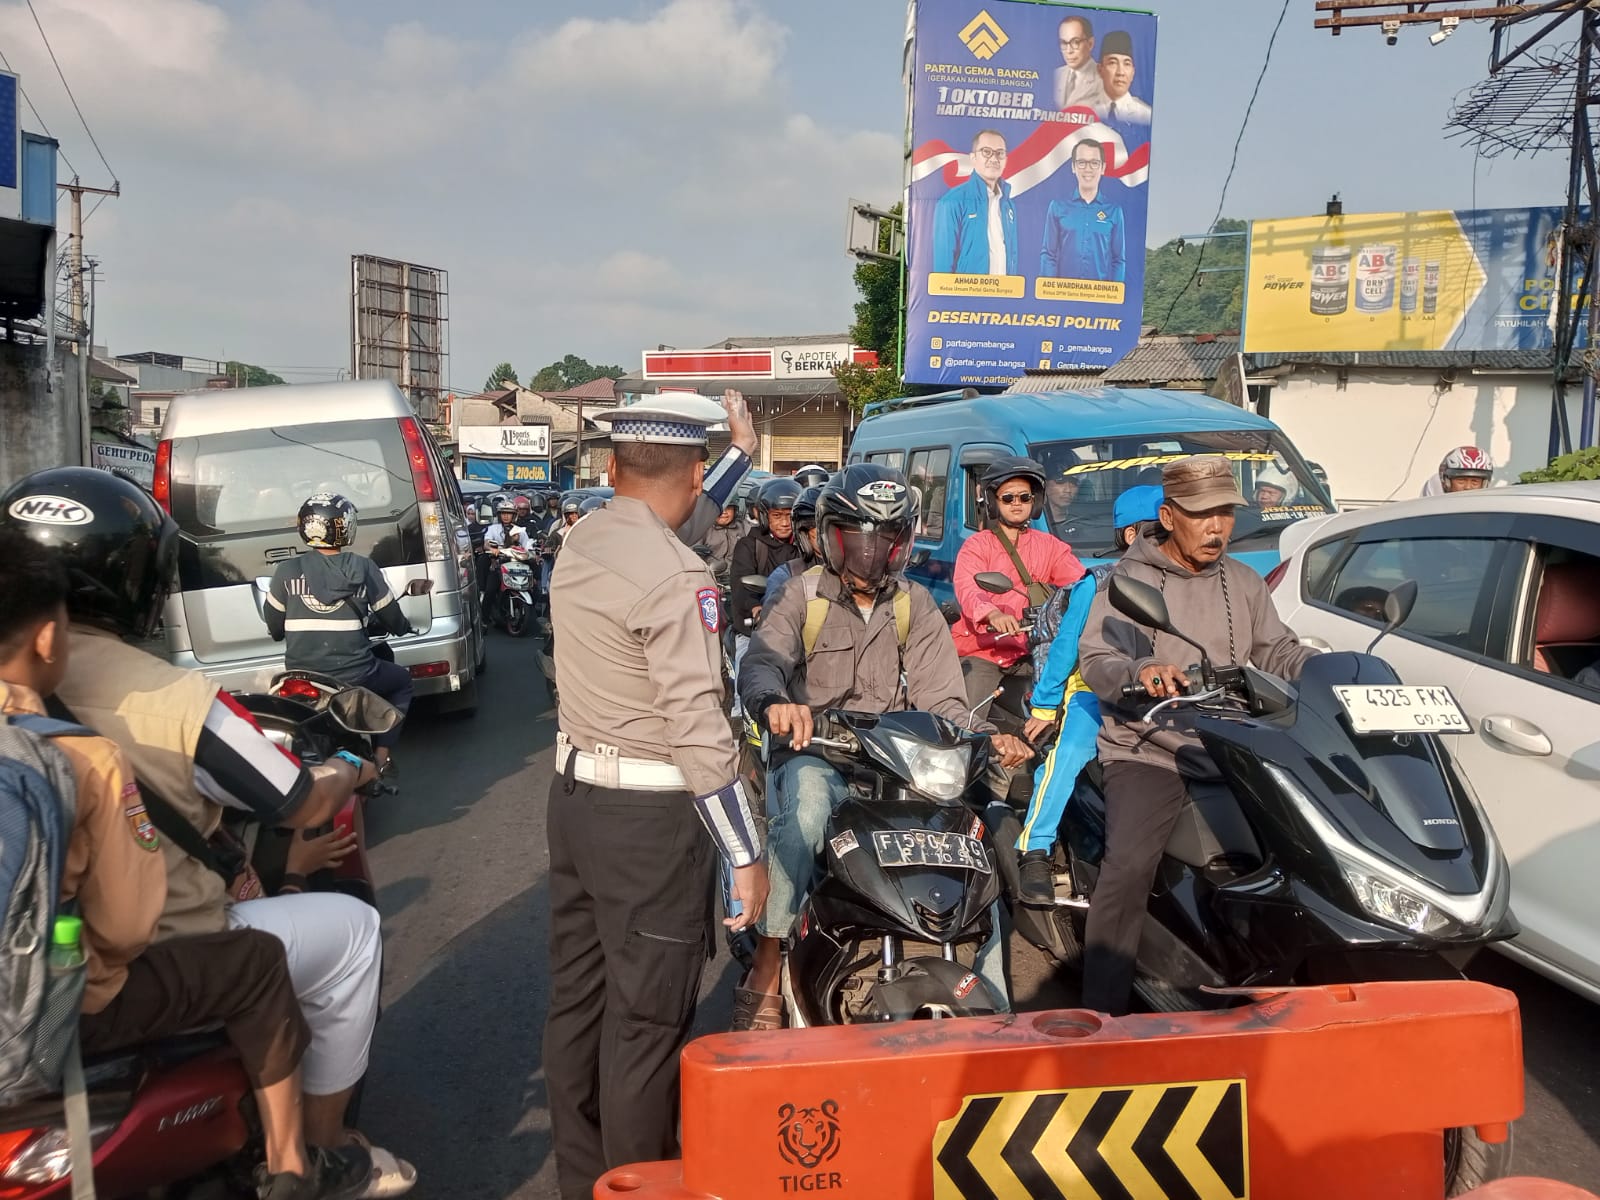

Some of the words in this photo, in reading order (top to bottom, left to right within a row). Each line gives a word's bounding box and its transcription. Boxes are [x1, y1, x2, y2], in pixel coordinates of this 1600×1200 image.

[924, 63, 962, 74] PARTAI
[964, 66, 994, 76] GEMA
[997, 68, 1039, 79] BANGSA
[927, 74, 966, 82] (GERAKAN
[967, 76, 999, 85] MANDIRI
[1000, 79, 1033, 88] BANGSA)
[939, 86, 949, 103] 1
[951, 88, 1034, 108] OKTOBER
[936, 104, 966, 116] HARI
[967, 105, 1032, 120] KESAKTIAN
[1032, 109, 1095, 124] PANCASILA
[1359, 253, 1396, 268] ABC
[1314, 264, 1347, 277] ABC
[954, 277, 979, 285] AHMAD
[980, 278, 1000, 286] ROFIQ
[1057, 282, 1092, 290] WARDHANA
[1093, 284, 1119, 292] ADINATA
[1263, 281, 1304, 291] POWER
[1311, 290, 1347, 304] POWER
[1365, 287, 1383, 295] CELL
[927, 311, 1061, 328] DESENTRALISASI
[1063, 316, 1122, 331] POLITIK
[945, 340, 1015, 350] partaigemabangsa
[1059, 344, 1113, 354] p_gemabangsa
[798, 351, 837, 361] APOTEK
[795, 360, 841, 371] BERKAH
[960, 375, 1021, 386] www.partaige
[500, 430, 515, 446] AL
[97, 445, 127, 458] GEHU
[17, 501, 81, 519] NHK
[1340, 689, 1351, 707] F
[1366, 689, 1411, 707] 4325
[1416, 688, 1453, 706] FKX
[1423, 818, 1460, 826] HONDA
[880, 834, 892, 850] F
[778, 1172, 842, 1193] TIGER
